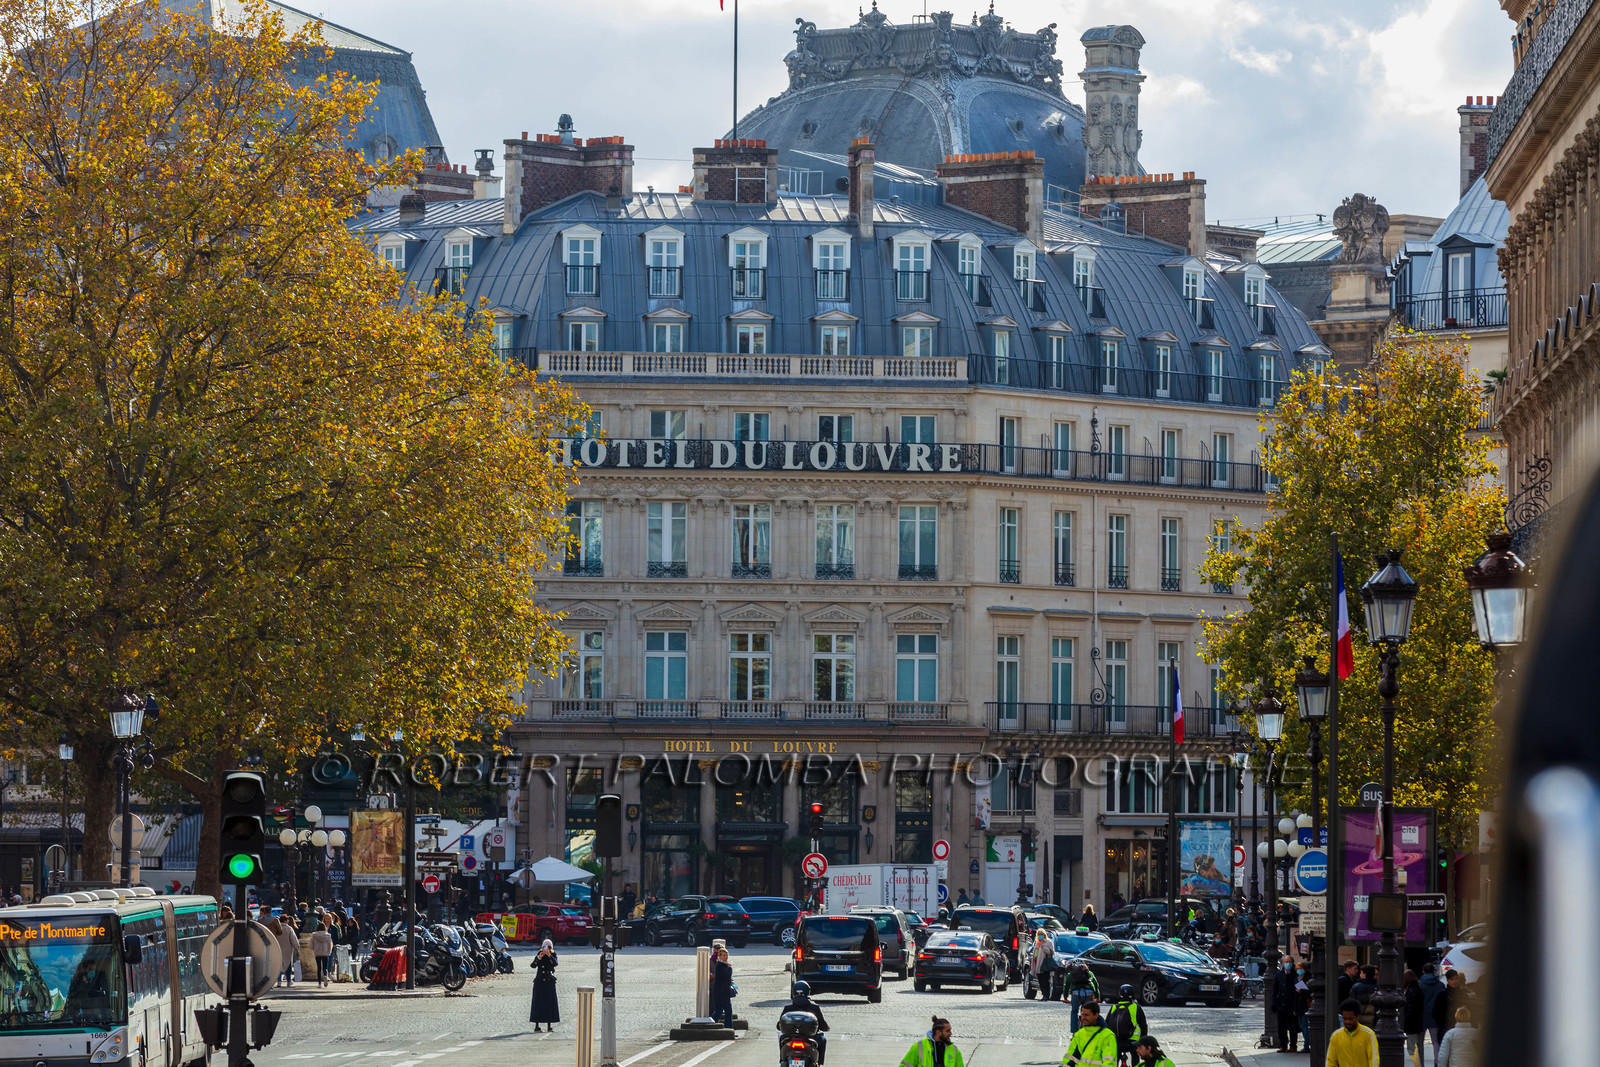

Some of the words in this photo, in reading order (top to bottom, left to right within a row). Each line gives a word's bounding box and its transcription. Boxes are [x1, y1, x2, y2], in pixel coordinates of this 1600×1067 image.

[546, 438, 695, 468] HOTEL
[709, 440, 769, 469] DU
[782, 441, 962, 472] LOUVRE
[664, 740, 715, 753] HOTEL
[729, 741, 753, 753] DU
[773, 741, 838, 754] LOUVRE
[1363, 790, 1383, 801] BUS
[463, 838, 470, 848] P
[0, 925, 21, 940] Pte
[24, 927, 37, 938] de
[40, 922, 106, 938] Montmartre
